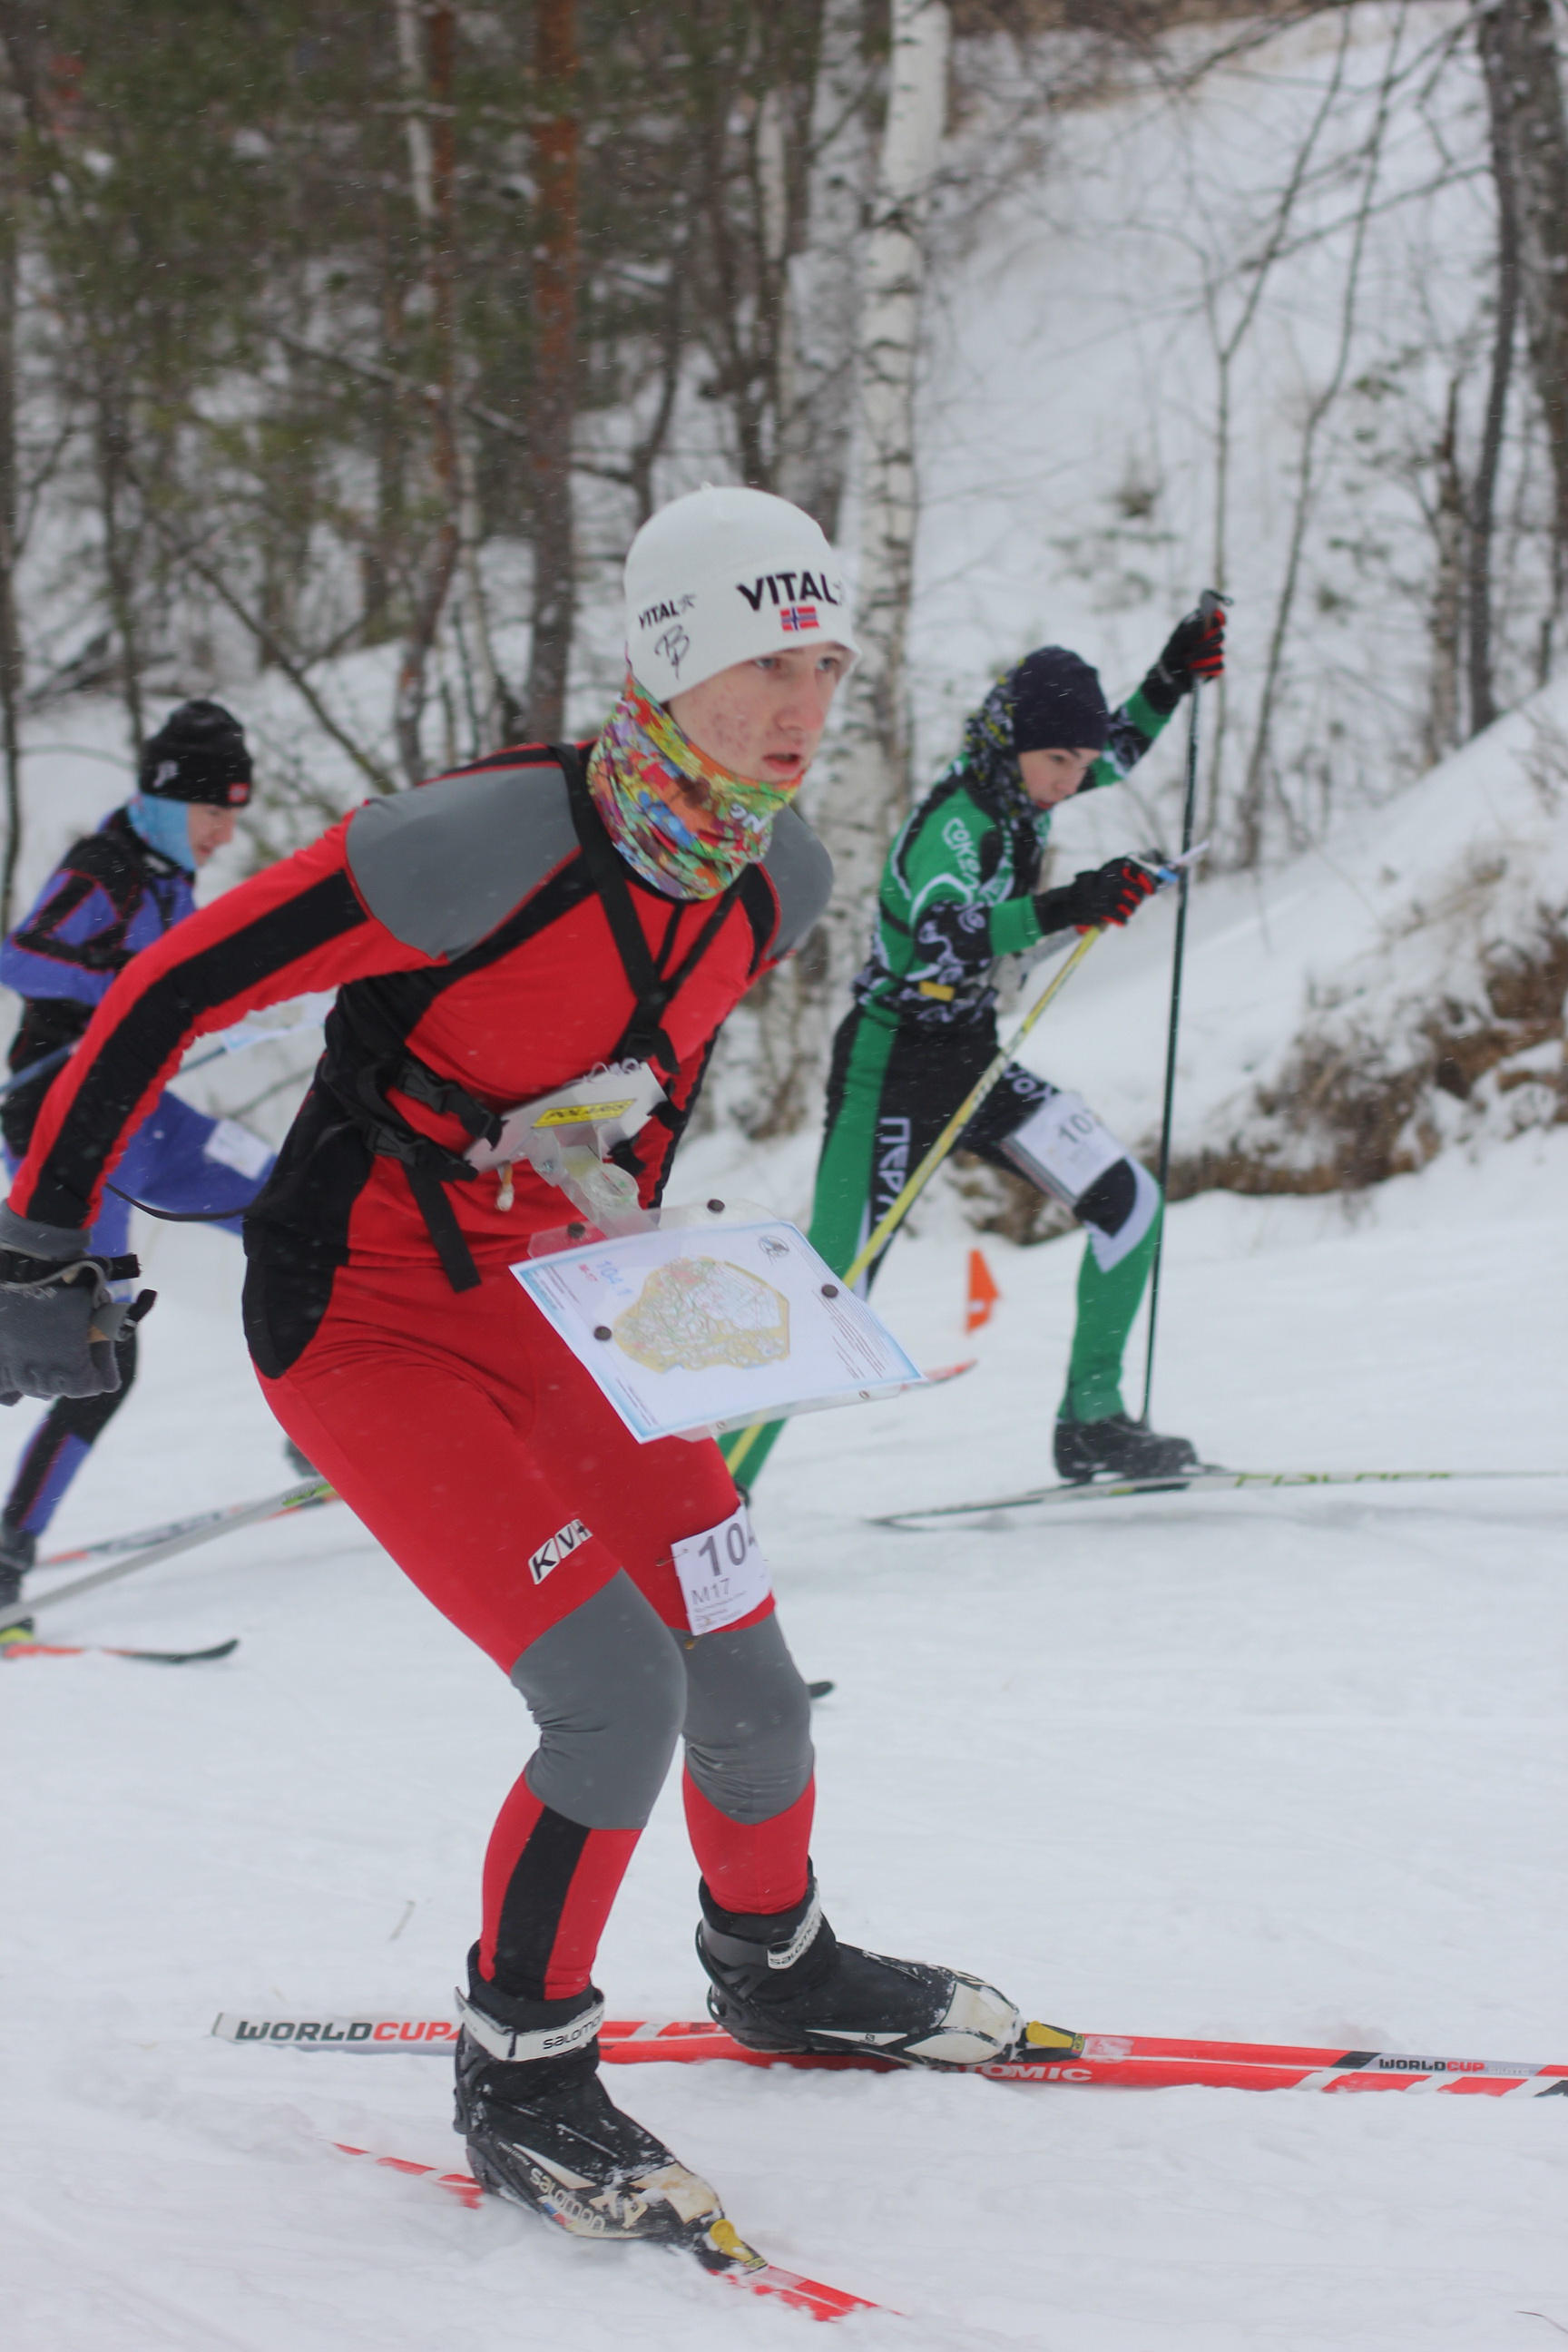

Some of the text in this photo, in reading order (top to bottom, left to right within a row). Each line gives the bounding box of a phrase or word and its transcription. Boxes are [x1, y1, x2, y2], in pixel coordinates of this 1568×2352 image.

[736, 571, 839, 612] VITAL
[638, 598, 680, 631] VITAL
[691, 1578, 731, 1605] M17
